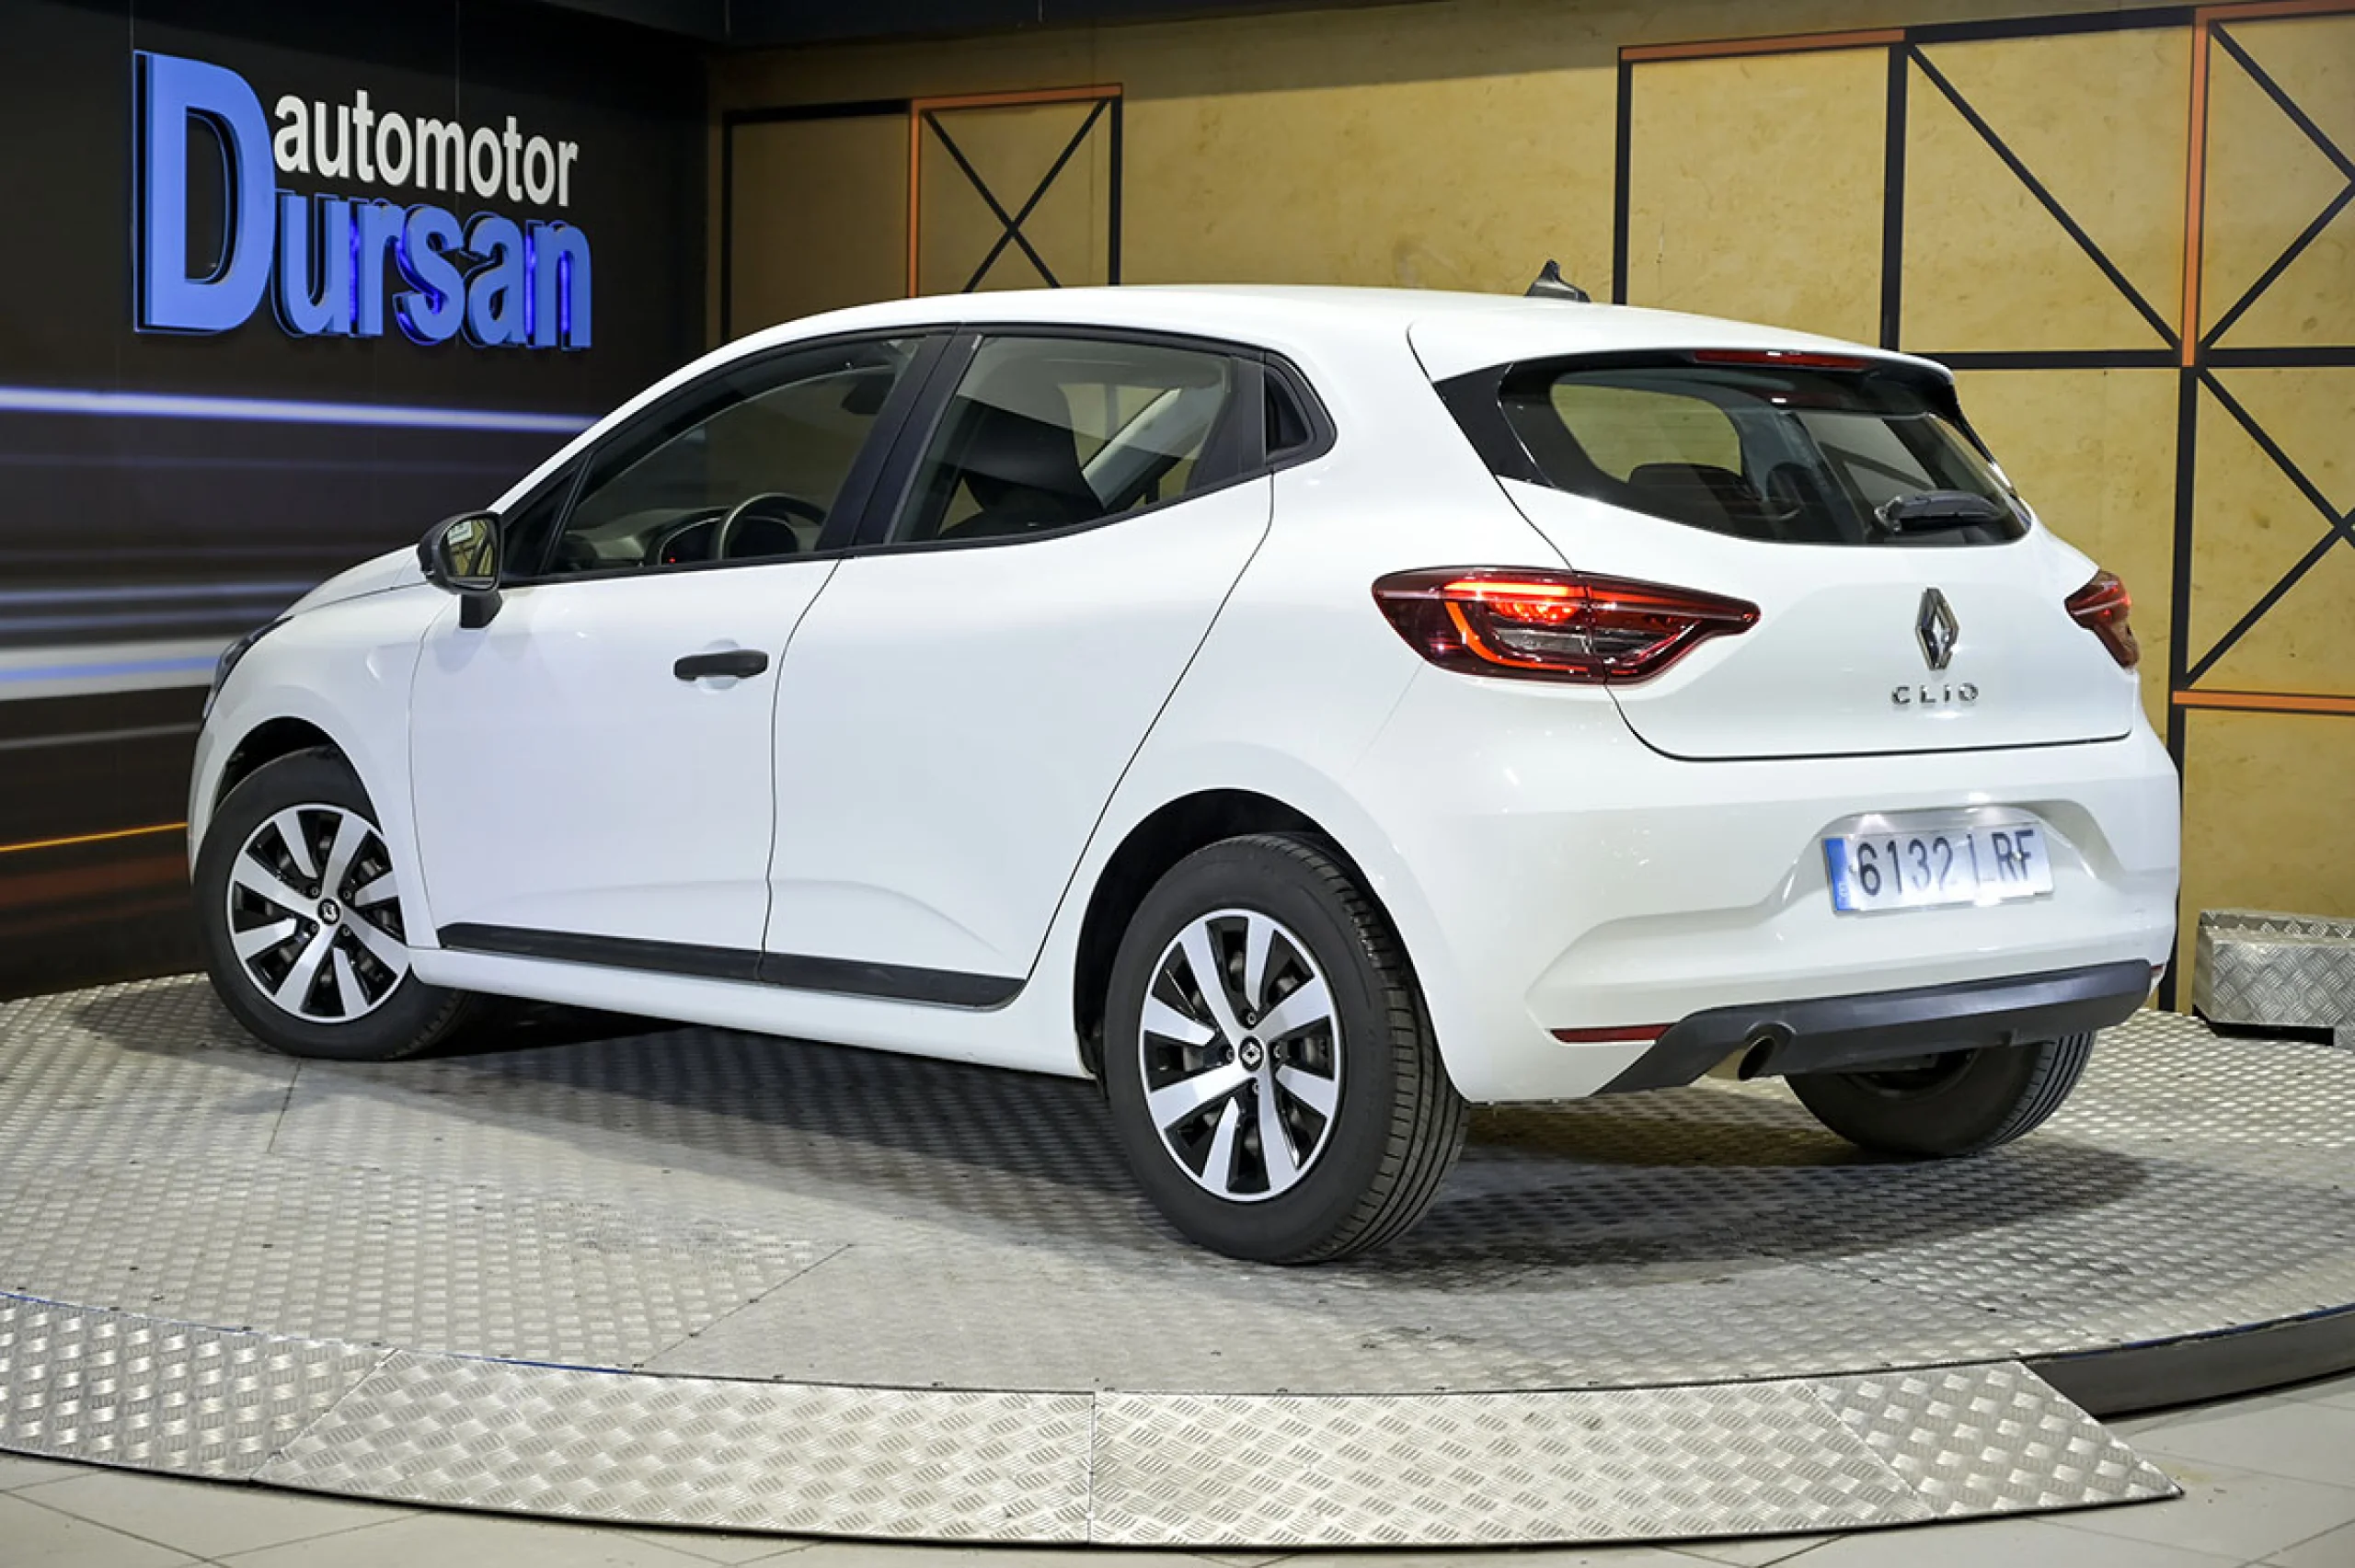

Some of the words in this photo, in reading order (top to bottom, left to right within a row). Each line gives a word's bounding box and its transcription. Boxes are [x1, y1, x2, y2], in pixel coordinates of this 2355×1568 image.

[274, 89, 580, 207] automotor
[133, 49, 592, 351] Dursan
[1891, 682, 1979, 704] CLIO
[1856, 835, 1954, 897] 6132
